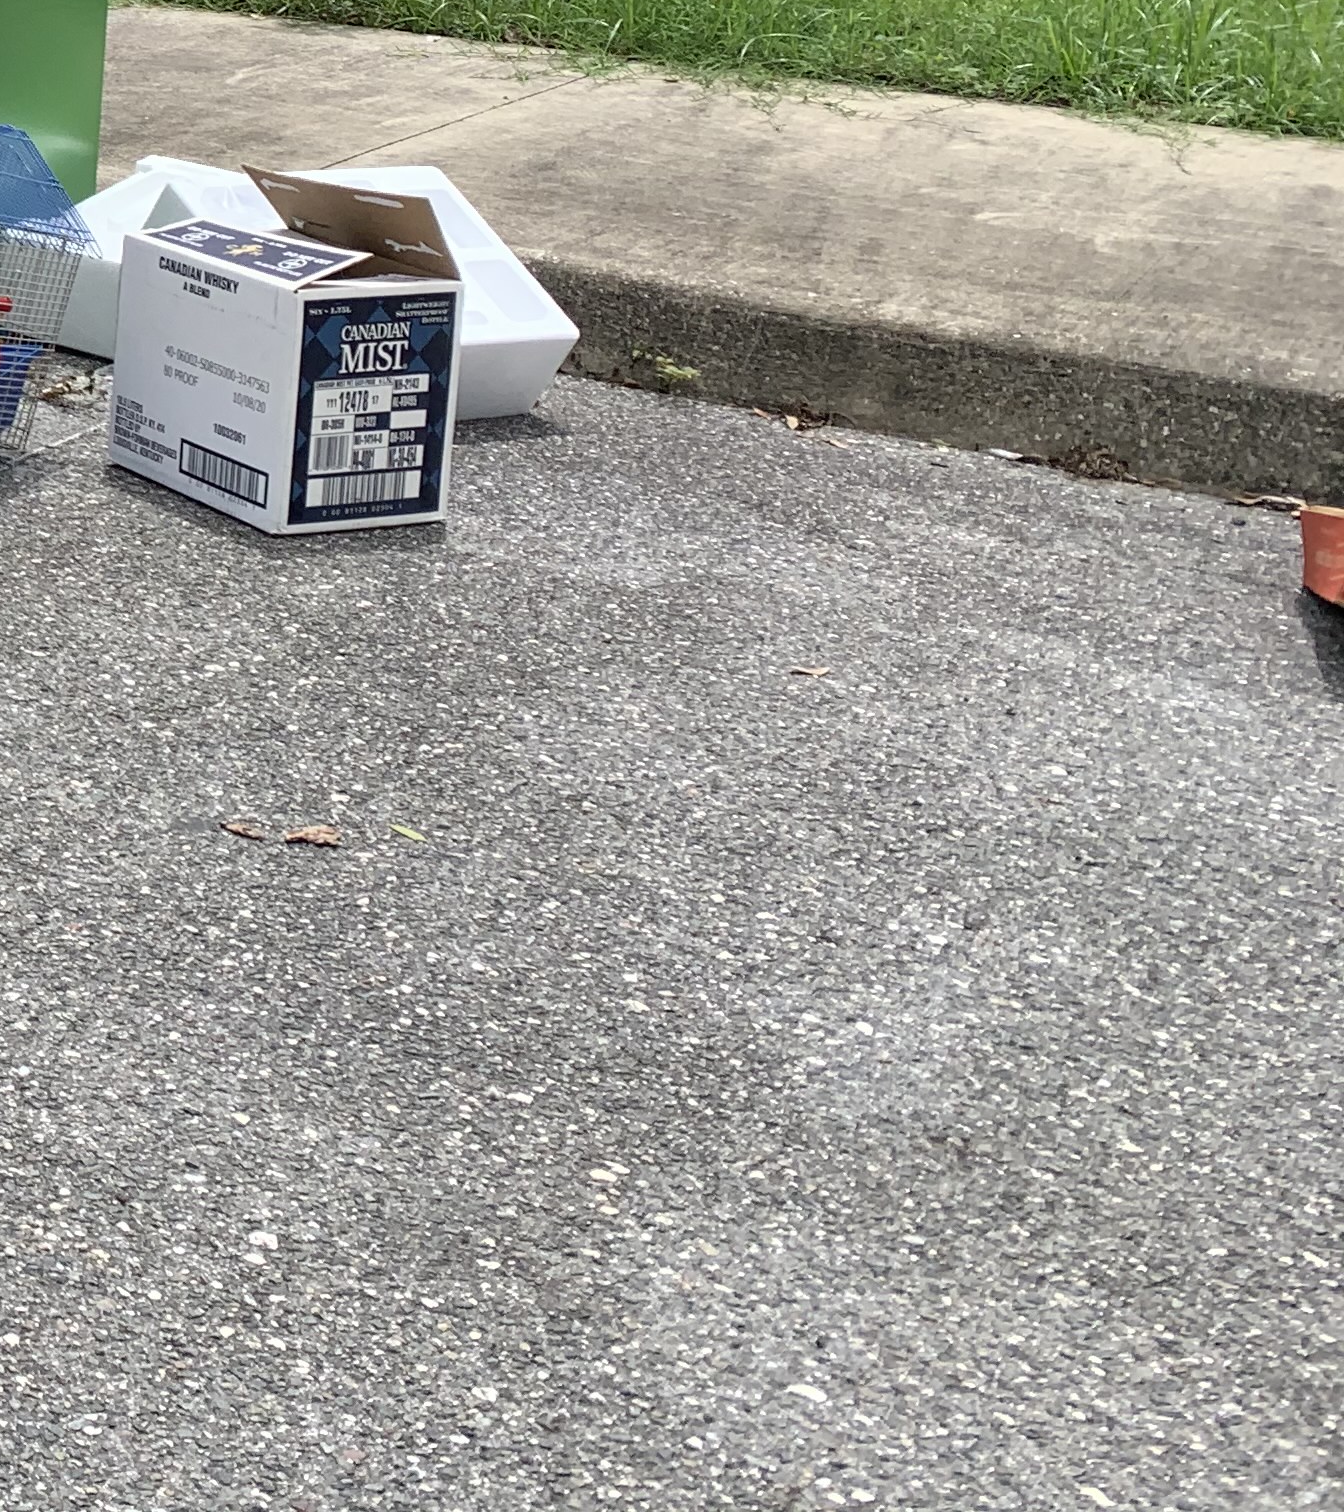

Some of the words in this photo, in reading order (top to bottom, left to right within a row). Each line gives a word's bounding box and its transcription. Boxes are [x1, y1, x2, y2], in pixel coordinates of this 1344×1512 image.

[158, 256, 203, 281] CANADIAN
[203, 269, 240, 295] WHISKY
[183, 281, 189, 291] A
[189, 283, 211, 299] BLEND
[341, 322, 411, 342] CANADIAN
[338, 340, 410, 375] MIST
[174, 368, 199, 387] PROOF
[339, 390, 370, 414] 12478
